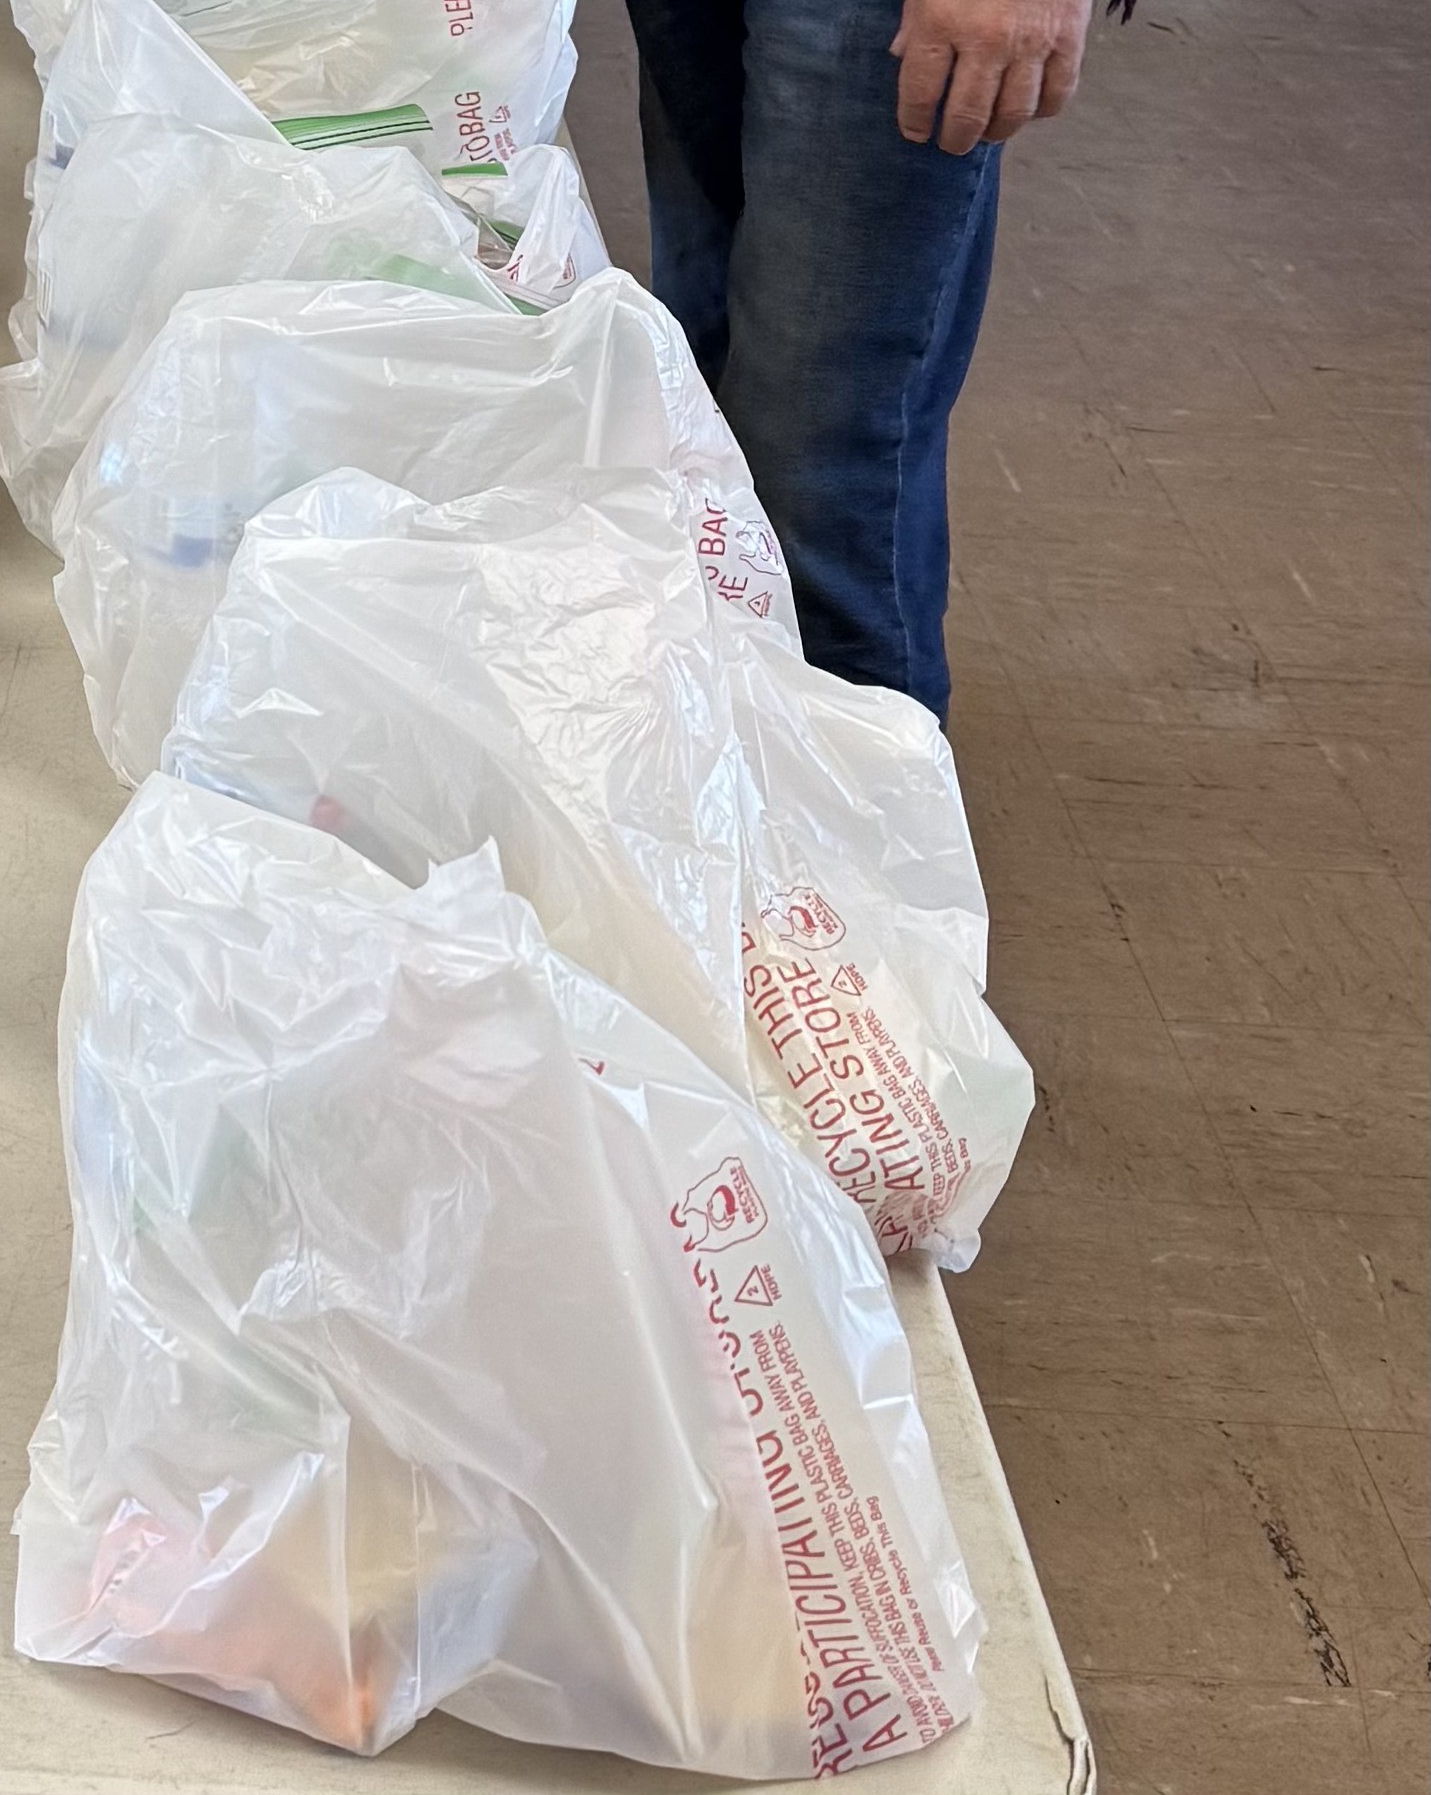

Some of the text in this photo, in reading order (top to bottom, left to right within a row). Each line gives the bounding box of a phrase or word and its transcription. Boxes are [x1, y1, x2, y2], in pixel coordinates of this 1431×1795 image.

[743, 965, 802, 1058] THIS
[777, 959, 864, 1079] STORE
[846, 1011, 872, 1045] FROM
[863, 1046, 891, 1076] AWAY
[892, 1055, 915, 1079] AND
[883, 1074, 906, 1100] BAG
[730, 1167, 755, 1224] RECYCLE
[746, 1285, 759, 1297] 2
[760, 1264, 782, 1301] HDPE
[749, 1330, 777, 1373] FROM
[769, 1323, 807, 1393] PLAYPENS.
[765, 1374, 795, 1412] AWAY
[798, 1391, 821, 1420] AND
[784, 1413, 809, 1446] BAG
[797, 1445, 832, 1503] PLASTIC
[811, 1419, 853, 1500] CARRIAGES,
[821, 1502, 845, 1538] THIS
[844, 1497, 870, 1540] BEDS,
[866, 1495, 883, 1522] Bag
[877, 1521, 894, 1549] This
[834, 1538, 860, 1572] KEEP
[859, 1536, 886, 1582] CRIBS,
[874, 1579, 892, 1596] IN
[888, 1550, 912, 1596] Recycle
[757, 1432, 908, 1752] A PARTICIPATING
[880, 1594, 902, 1622] BAG
[905, 1597, 919, 1610] or
[911, 1612, 931, 1646] Reuse
